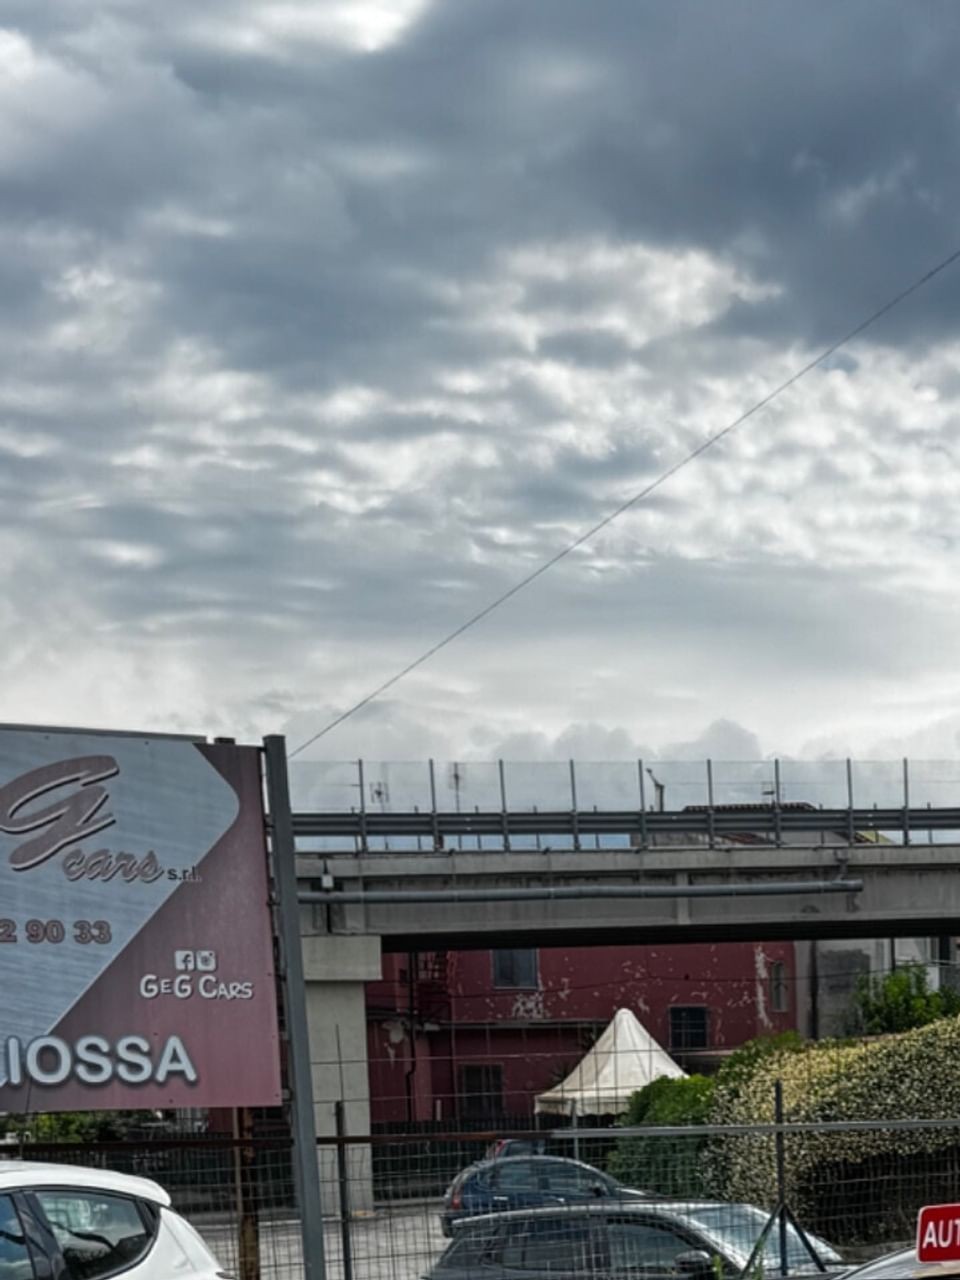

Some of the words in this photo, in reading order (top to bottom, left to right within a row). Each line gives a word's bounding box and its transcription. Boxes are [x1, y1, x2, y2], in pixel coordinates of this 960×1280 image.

[62, 848, 163, 883] cars
[25, 919, 65, 944] 90
[73, 920, 112, 944] 33
[0, 1035, 196, 1087] IOSSA
